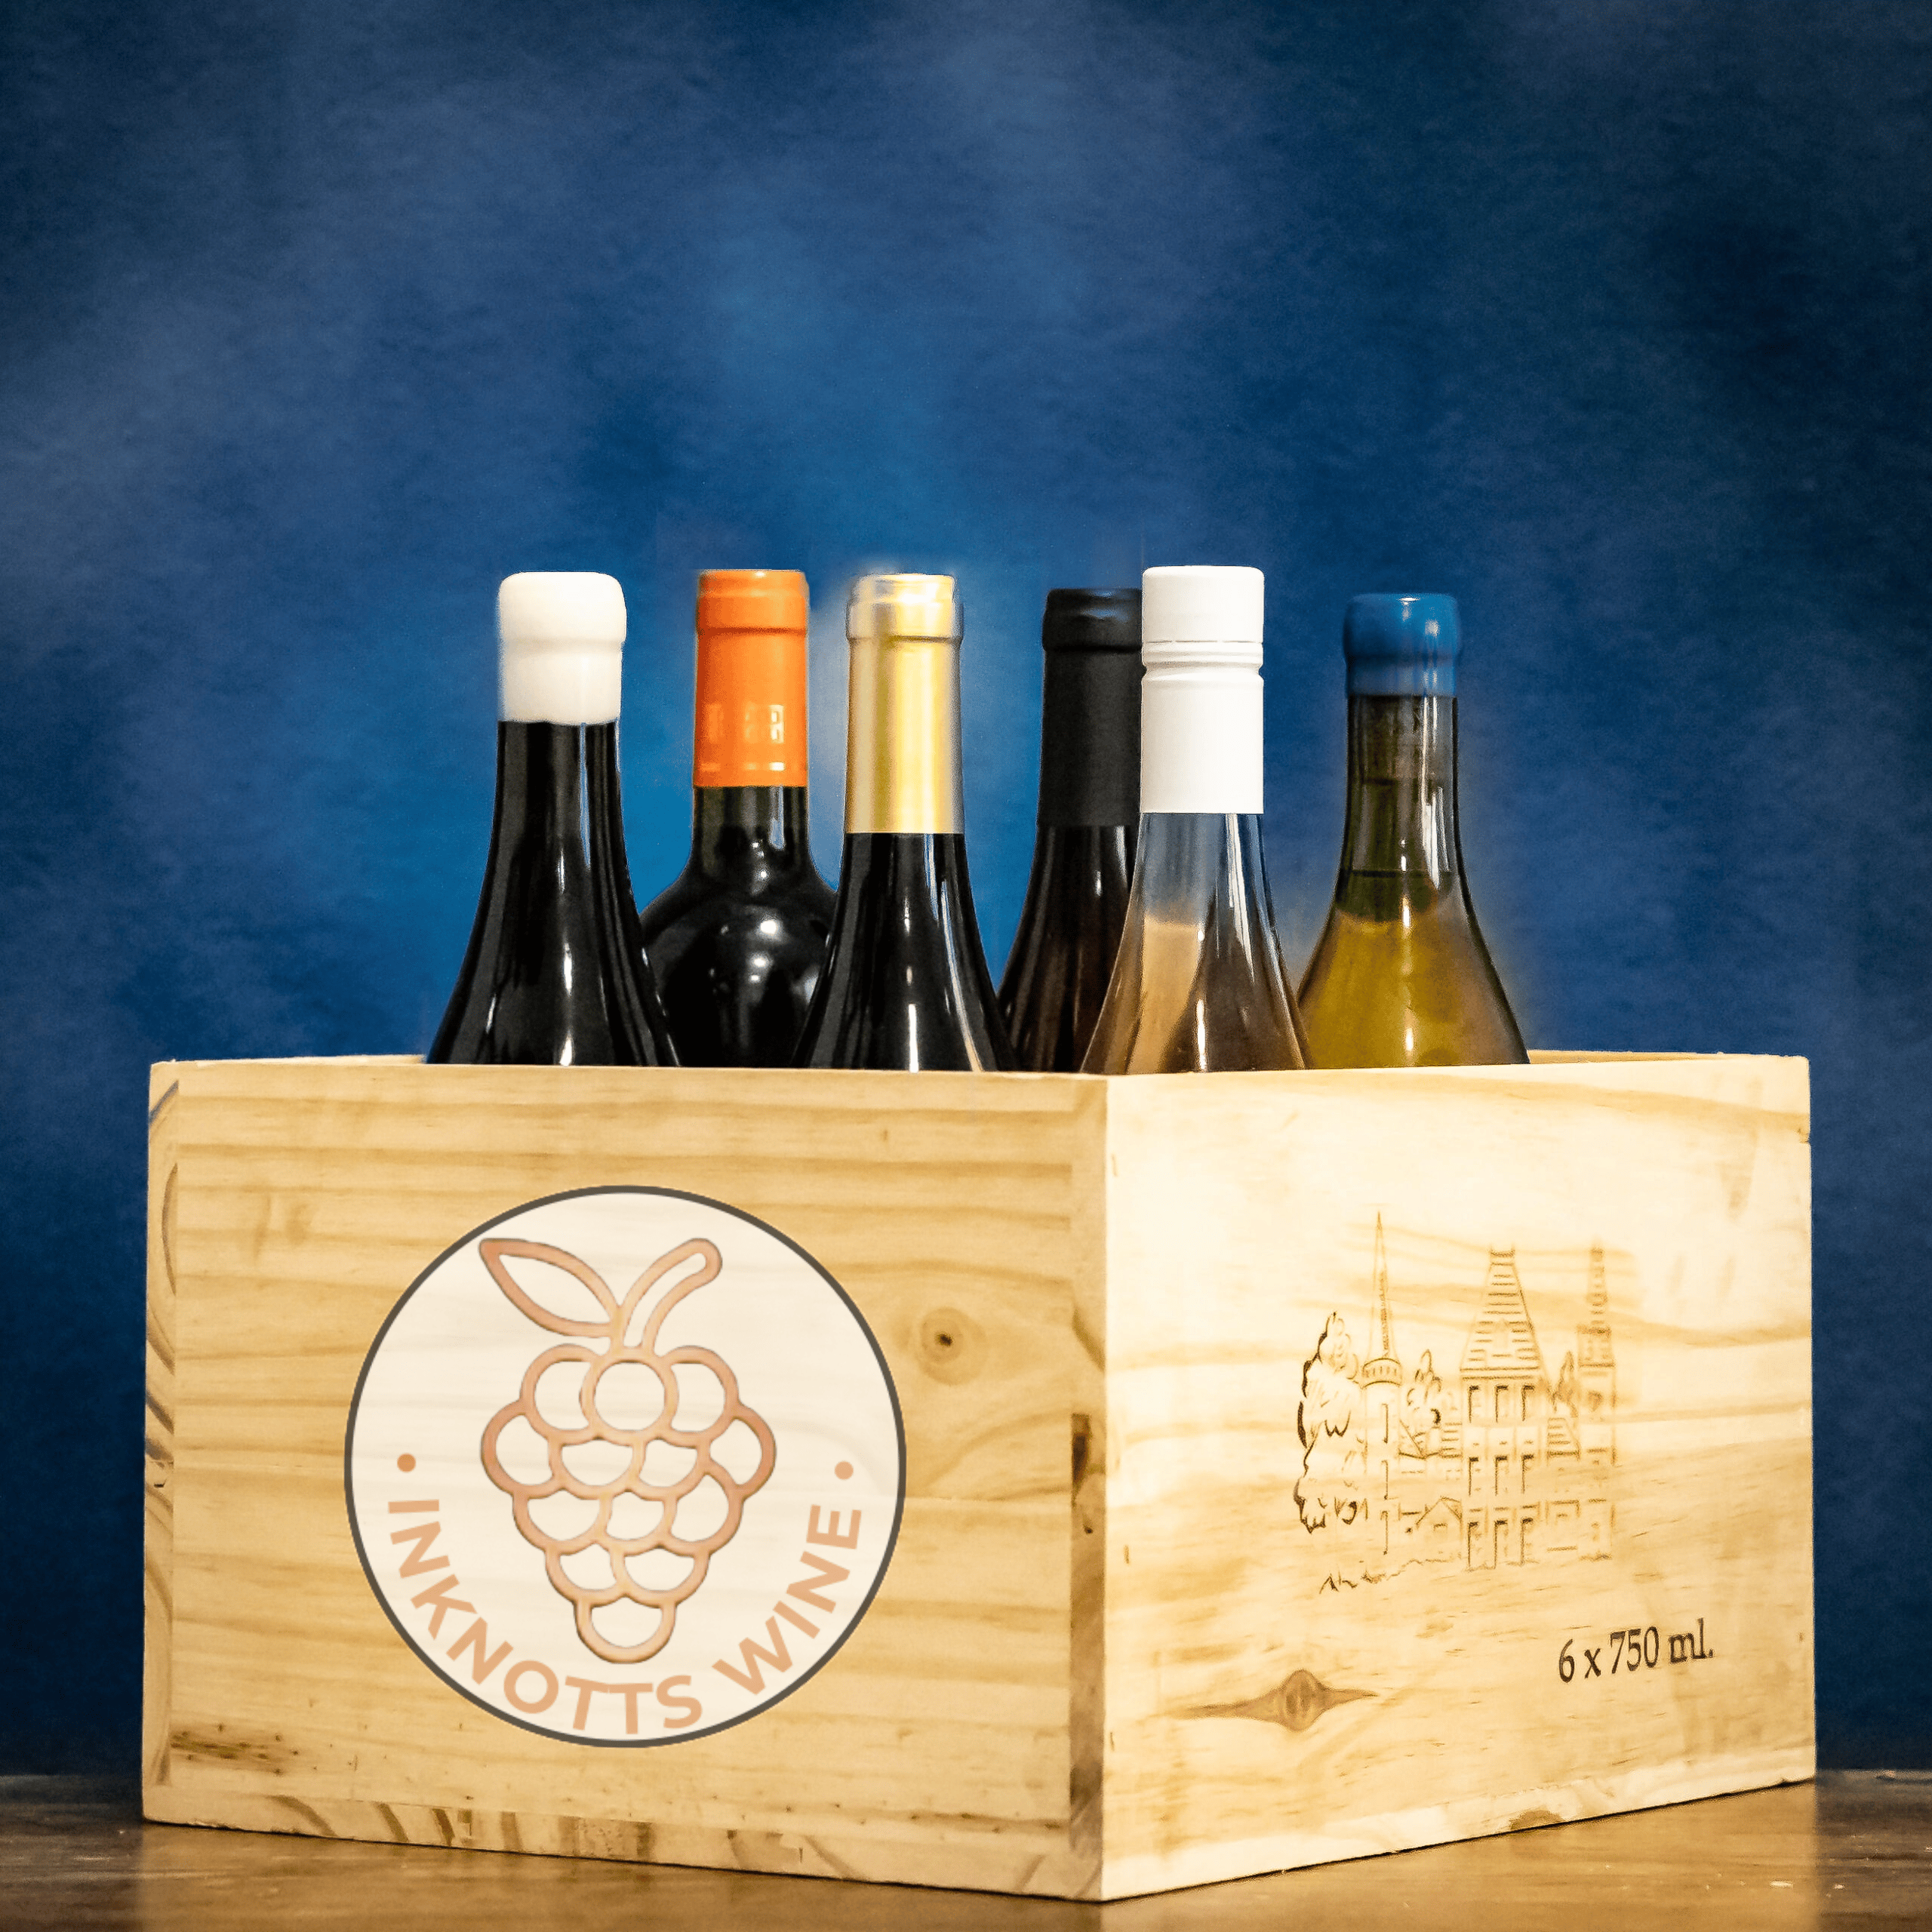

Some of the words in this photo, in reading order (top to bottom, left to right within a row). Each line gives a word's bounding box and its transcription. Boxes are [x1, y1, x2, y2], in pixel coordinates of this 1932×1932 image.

[387, 1498, 703, 1735] INKNOTTS
[712, 1504, 863, 1696] WINE
[1558, 1638, 1575, 1683] 6
[1584, 1647, 1601, 1678] x
[1610, 1626, 1660, 1674] 750
[1668, 1617, 1714, 1664] ml.
